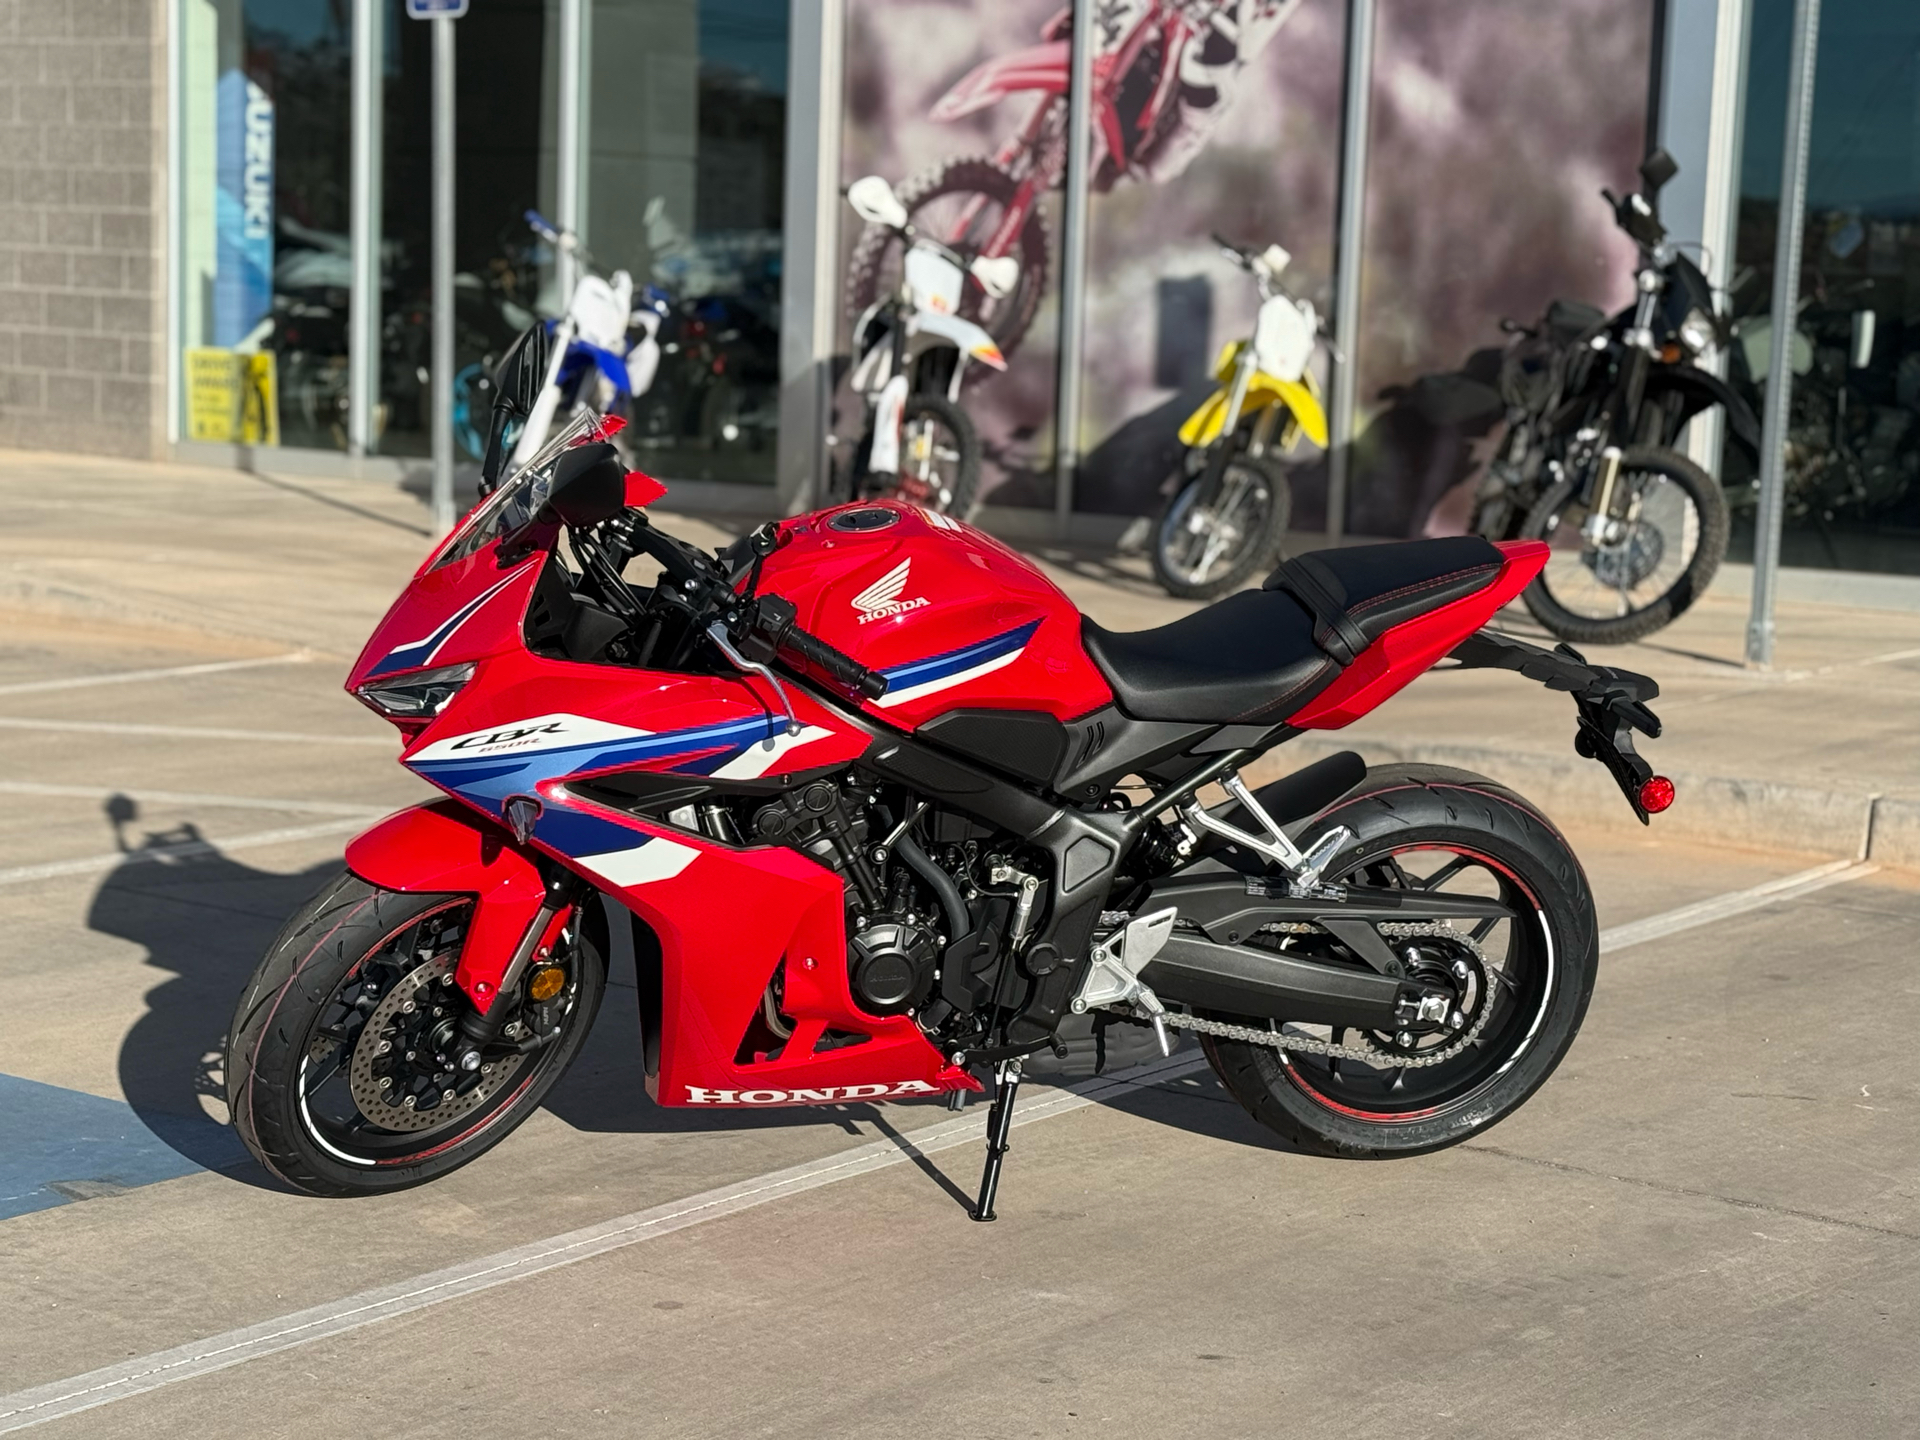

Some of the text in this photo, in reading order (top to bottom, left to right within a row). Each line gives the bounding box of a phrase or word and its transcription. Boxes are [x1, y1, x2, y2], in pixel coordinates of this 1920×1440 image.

[857, 597, 931, 625] HONDA
[450, 722, 569, 750] CBR
[684, 1079, 940, 1104] HONDA
